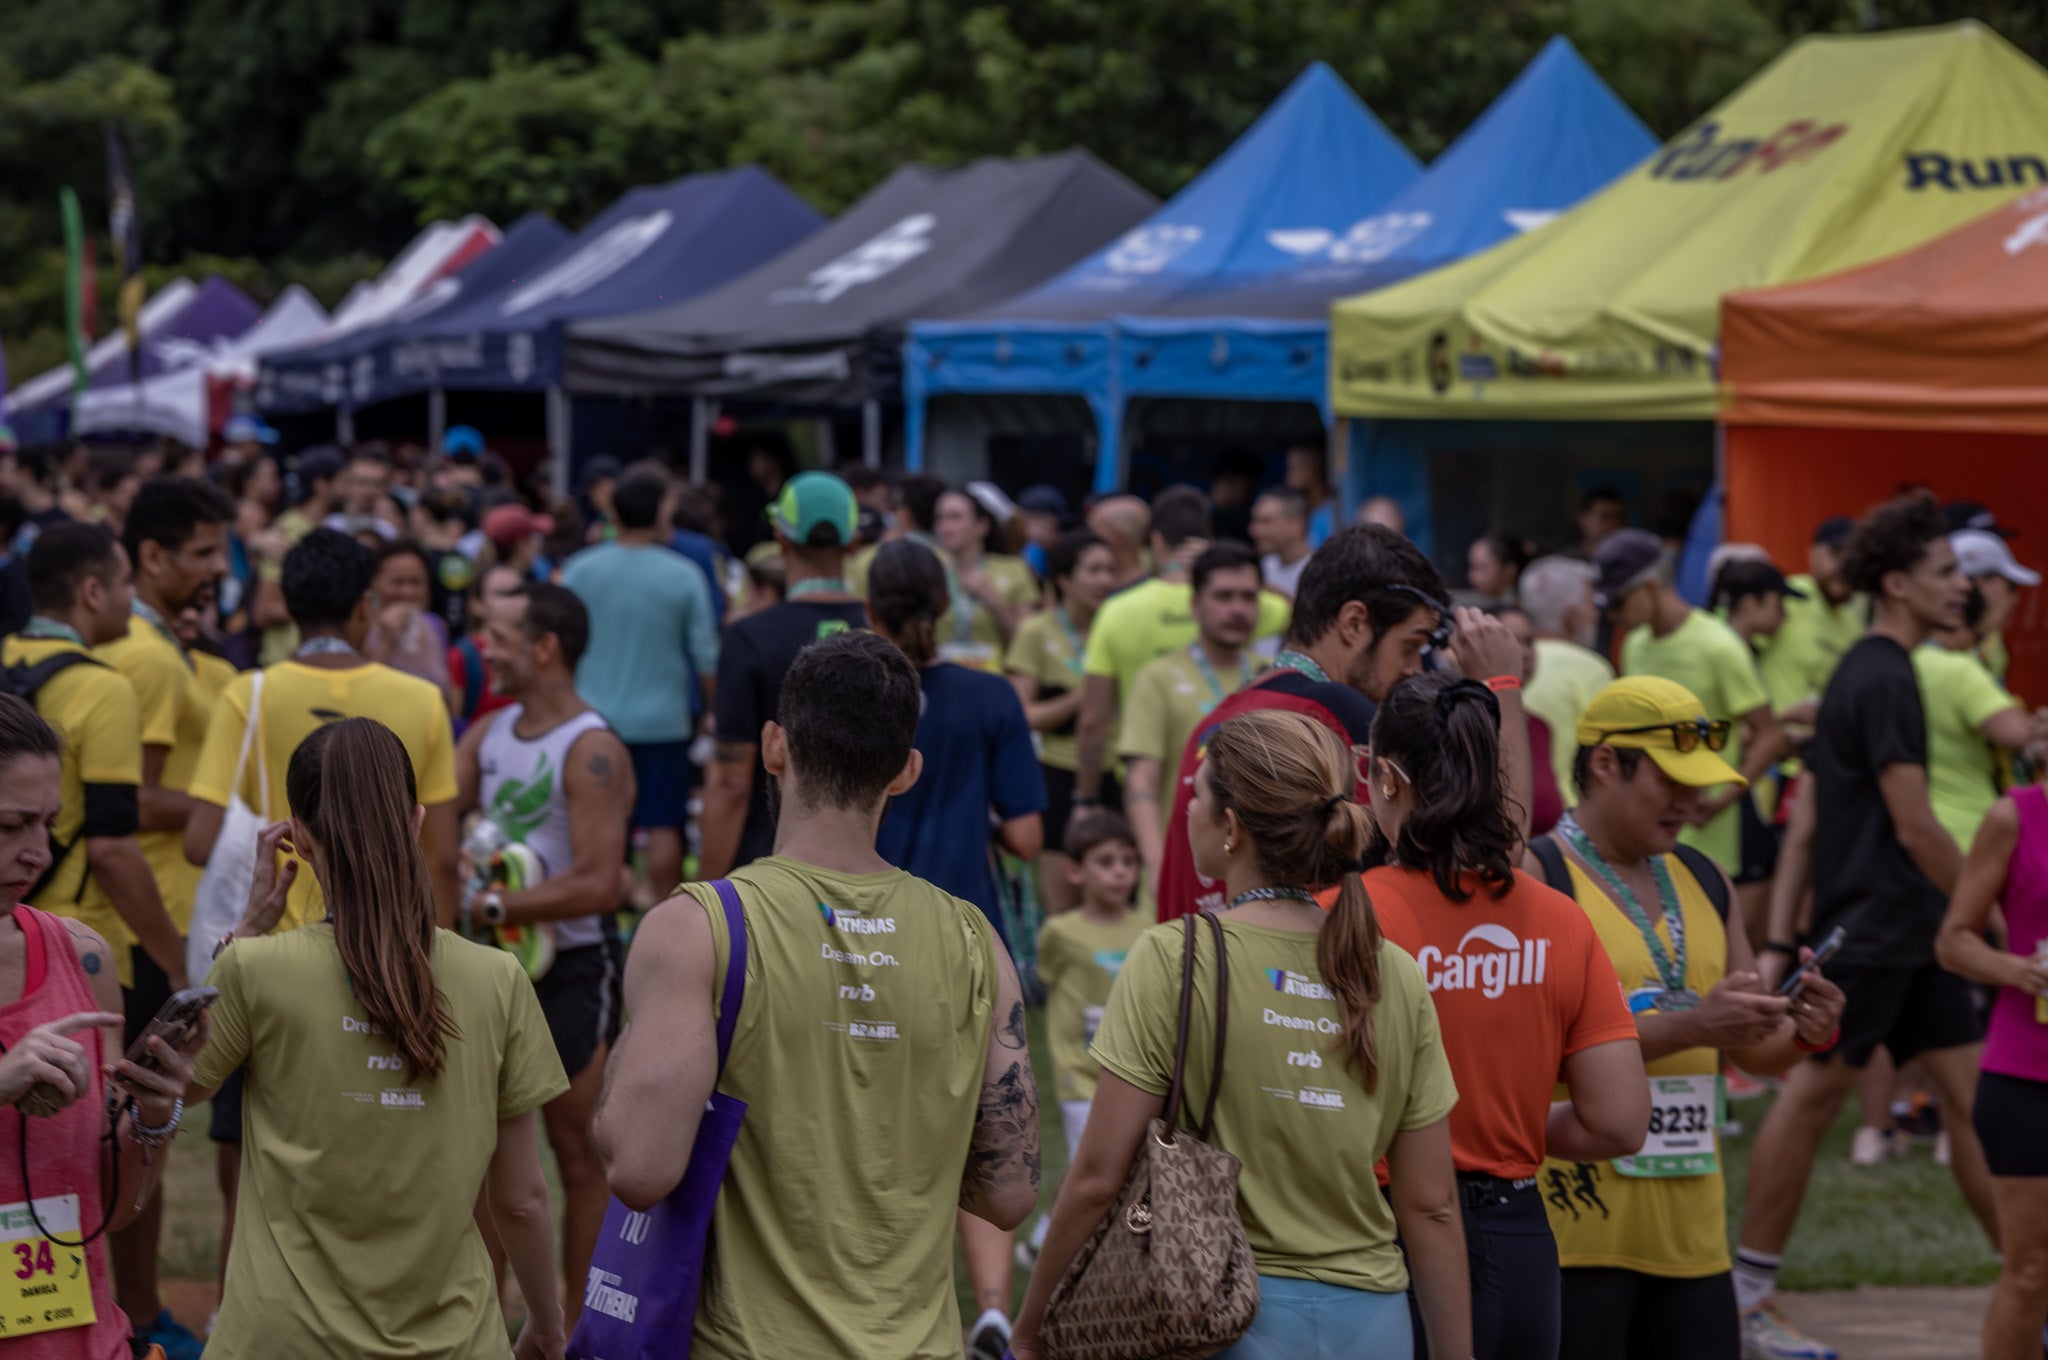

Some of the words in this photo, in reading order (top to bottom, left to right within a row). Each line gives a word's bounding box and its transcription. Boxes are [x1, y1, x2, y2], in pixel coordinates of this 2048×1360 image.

[836, 916, 897, 935] ATHENAS
[821, 942, 867, 967] Dream
[1417, 937, 1547, 999] Cargill
[840, 983, 876, 1002] rvb
[1284, 979, 1337, 1000] ATHEN
[342, 1015, 376, 1034] Dre
[1263, 1007, 1315, 1032] Dream
[849, 1022, 900, 1040] BRASIL
[1286, 1049, 1323, 1070] rvb
[1648, 1104, 1707, 1134] 8232
[12, 1240, 56, 1281] 34
